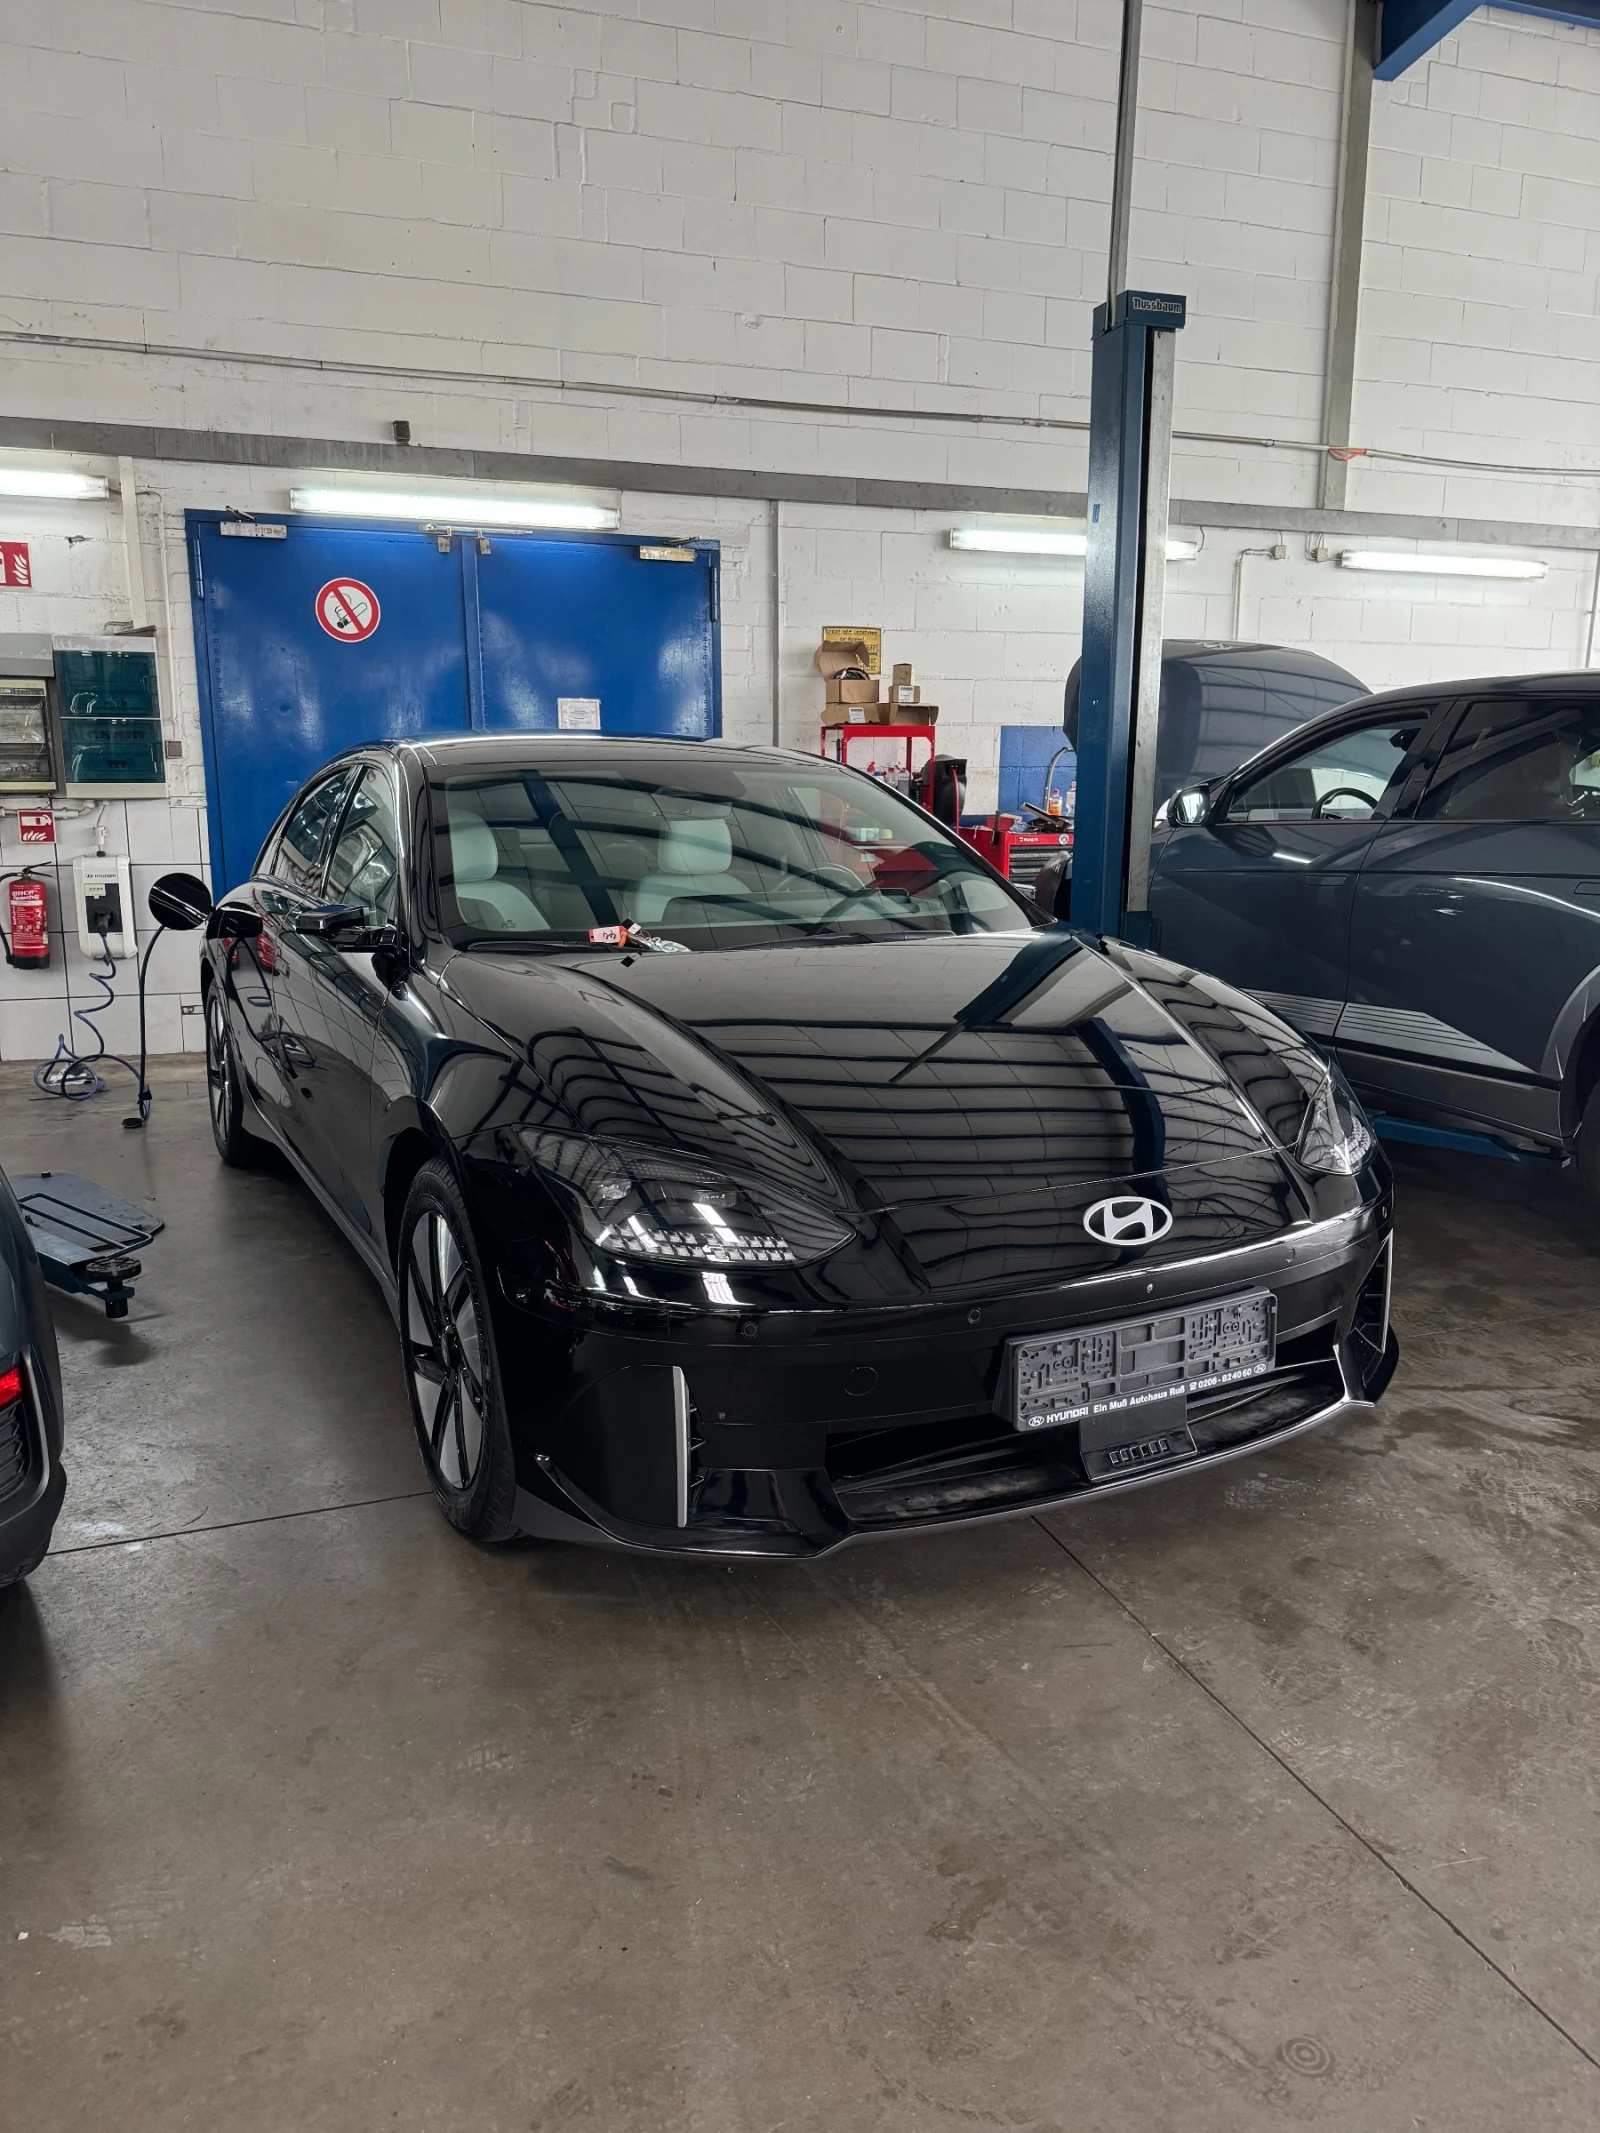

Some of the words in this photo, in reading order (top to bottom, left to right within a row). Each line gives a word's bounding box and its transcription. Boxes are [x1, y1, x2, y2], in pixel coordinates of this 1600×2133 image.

[1046, 1406, 1089, 1424] HYUNDAI
[1093, 1403, 1107, 1414] Ein
[1109, 1398, 1127, 1410] Muß
[1129, 1390, 1168, 1406] Autohaus
[1169, 1385, 1186, 1396] Ruß
[1198, 1376, 1217, 1389] 0208
